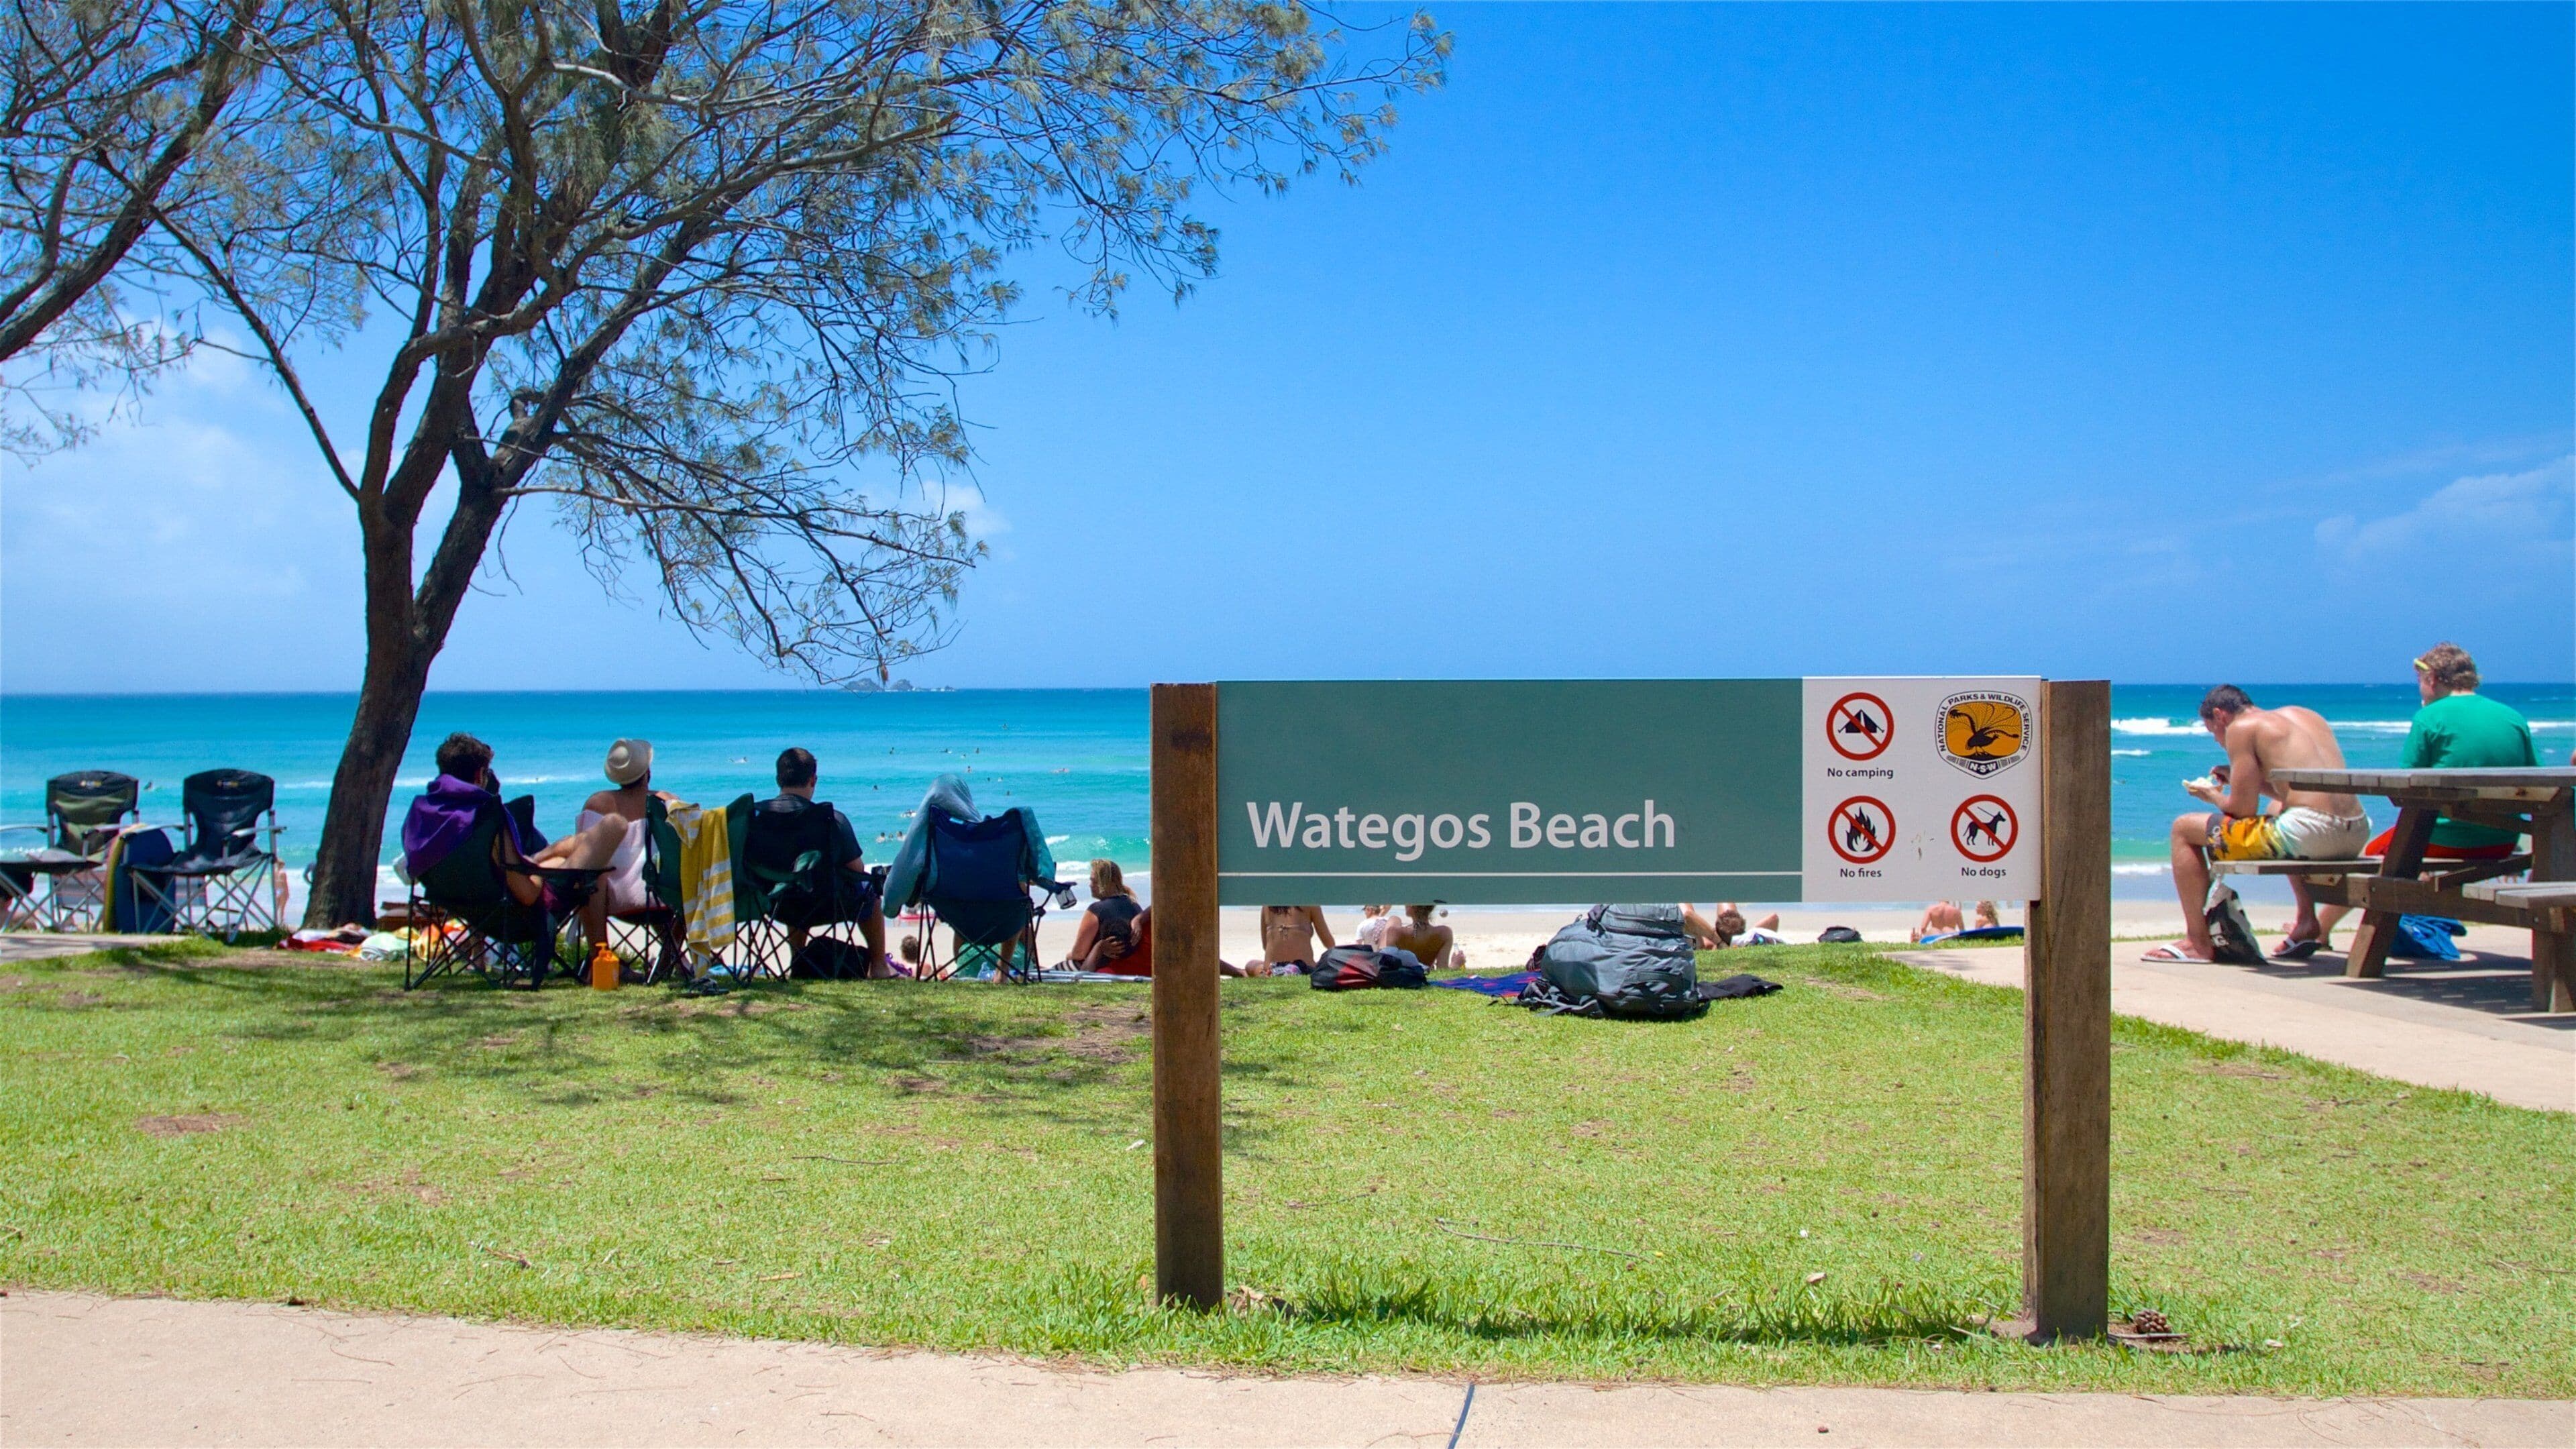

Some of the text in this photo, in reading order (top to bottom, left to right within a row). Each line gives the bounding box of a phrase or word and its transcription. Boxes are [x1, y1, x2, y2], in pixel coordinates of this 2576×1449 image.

[1937, 706, 1949, 751] NATIONAL
[1948, 694, 1979, 704] PARKS
[1988, 694, 2026, 712] WILDLIFE
[2022, 712, 2030, 751] SERVICE
[1827, 767, 1894, 780] No camping
[1246, 799, 1674, 861] Wategos Beach
[1839, 867, 1882, 878] No fires
[1961, 867, 2006, 879] No dogs
